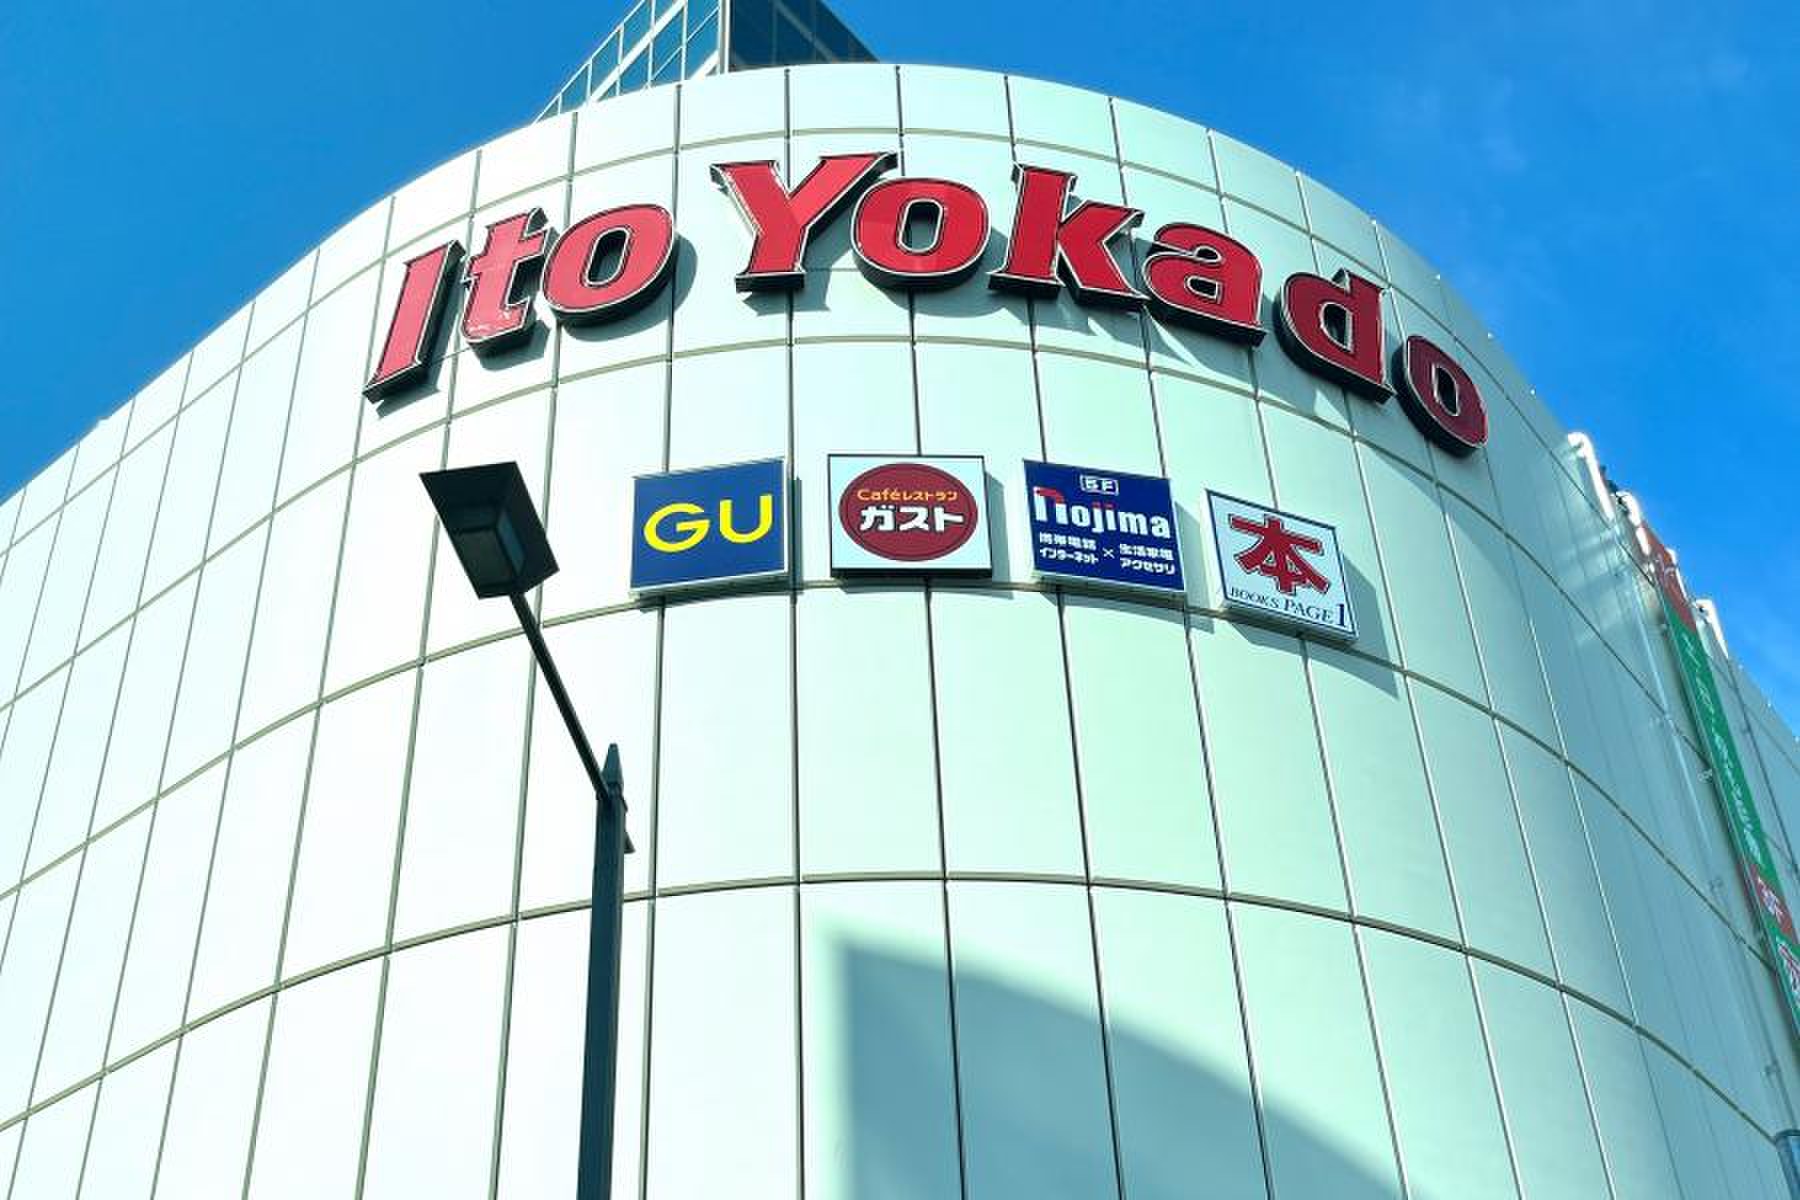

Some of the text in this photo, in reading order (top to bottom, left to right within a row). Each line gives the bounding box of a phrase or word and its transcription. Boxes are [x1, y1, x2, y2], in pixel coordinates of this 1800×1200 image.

[363, 152, 1488, 450] Ito Yokado
[644, 494, 773, 553] GU
[860, 504, 965, 532] ガスト
[1033, 486, 1170, 539] nojima
[1039, 547, 1099, 564] インターネット
[1119, 557, 1176, 575] アクセサリ
[1227, 513, 1332, 596] 本
[1229, 587, 1280, 609] BOOKS
[1283, 599, 1334, 624] PAGE
